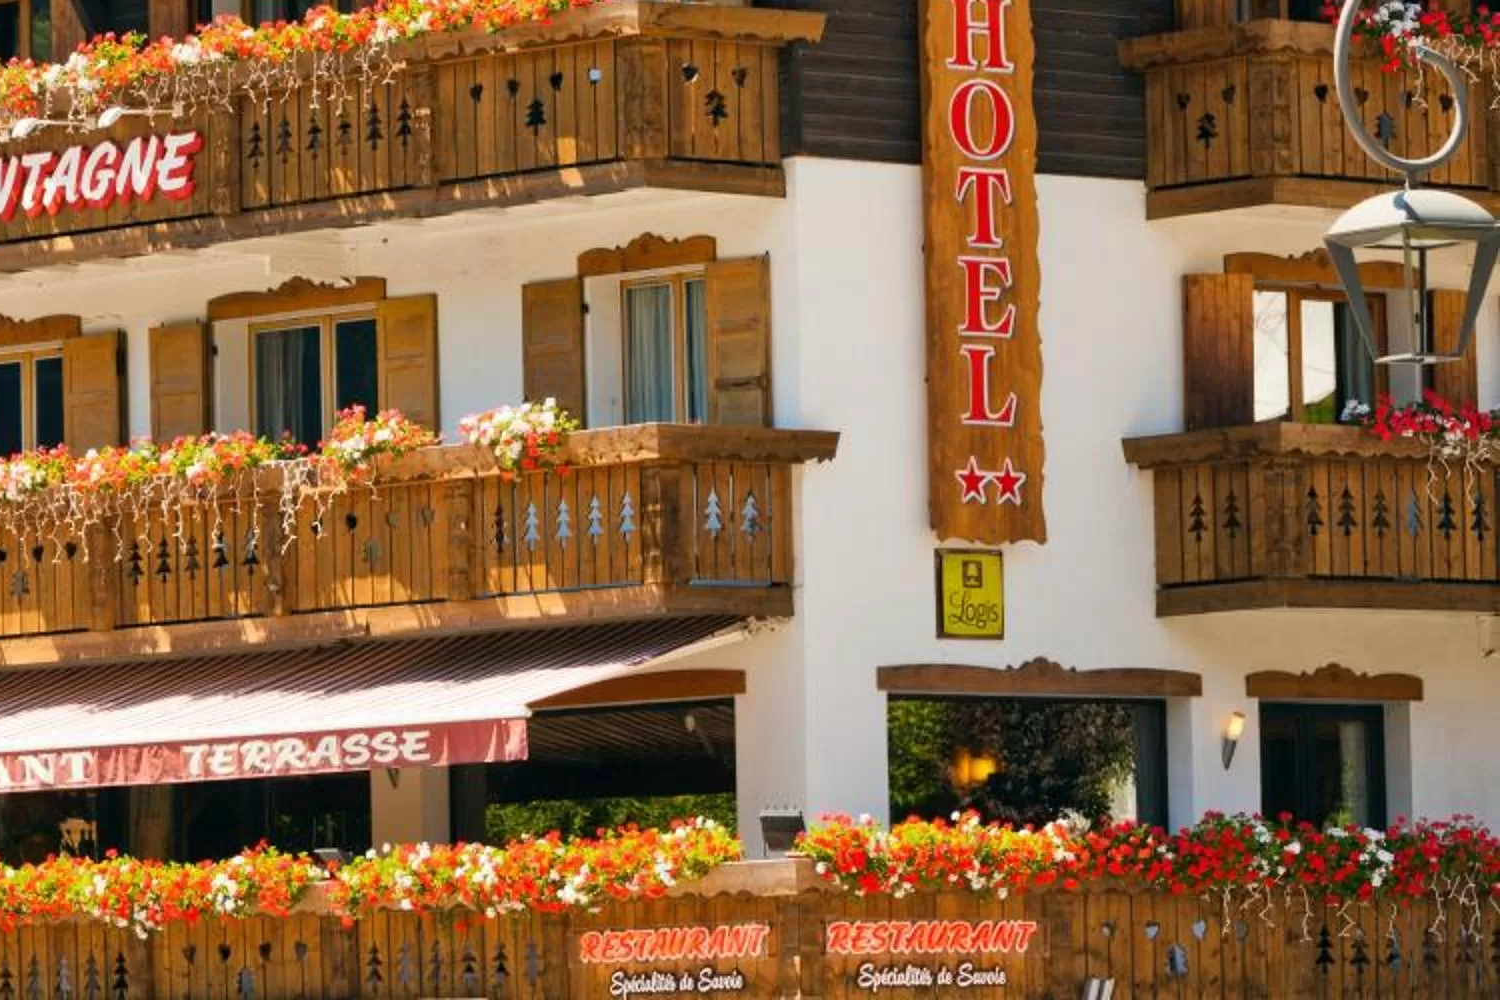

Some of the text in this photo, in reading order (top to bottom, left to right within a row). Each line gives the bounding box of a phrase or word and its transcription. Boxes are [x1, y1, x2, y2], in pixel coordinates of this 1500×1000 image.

[948, 591, 999, 629] Logis
[181, 730, 431, 776] TERRASSE
[580, 922, 770, 963] RESTAURANT
[827, 920, 1037, 954] RESTAURANT
[679, 973, 694, 992] de
[697, 967, 744, 993] Savoie
[858, 962, 1007, 993] Spécialités de Savoie
